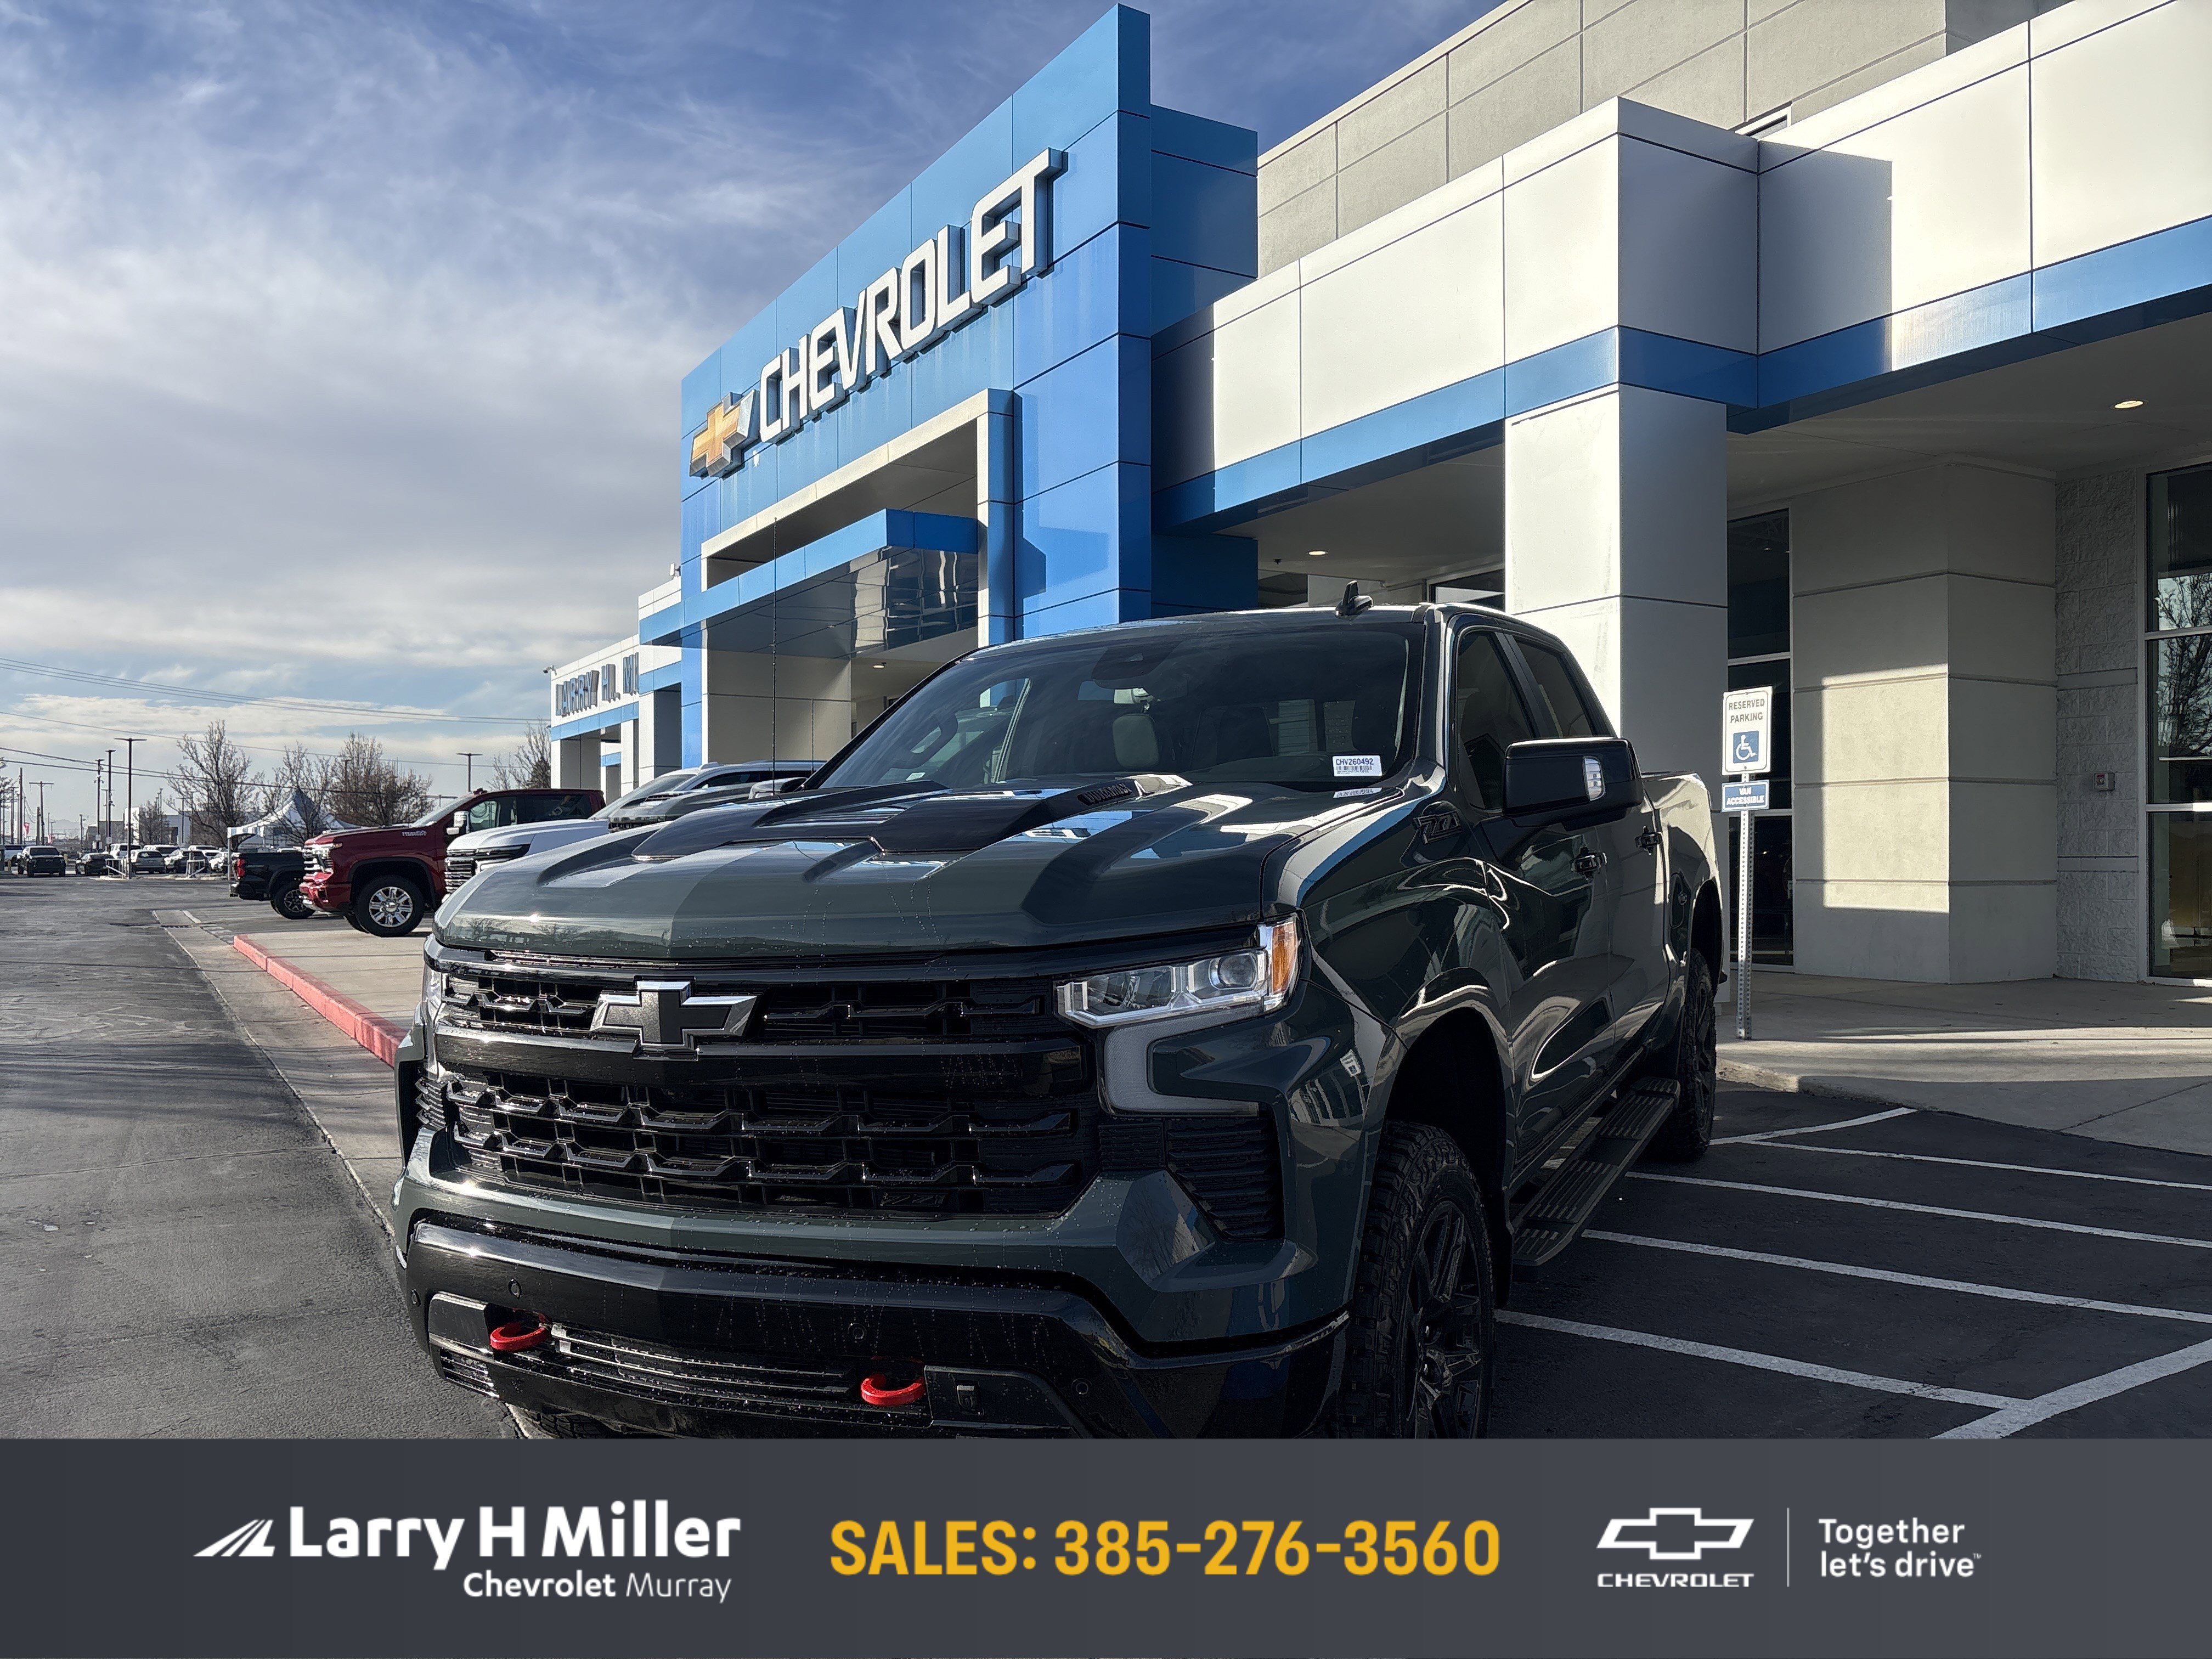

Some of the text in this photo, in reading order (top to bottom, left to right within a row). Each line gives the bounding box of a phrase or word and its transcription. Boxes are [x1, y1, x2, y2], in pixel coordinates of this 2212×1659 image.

[760, 147, 1065, 443] CHEVROLET
[556, 670, 600, 718] LARRY
[1728, 698, 1765, 710] RESERVED
[1730, 712, 1763, 724] PARKING
[1739, 786, 1752, 795] VAN
[1726, 795, 1764, 806] ACCESSIBLE
